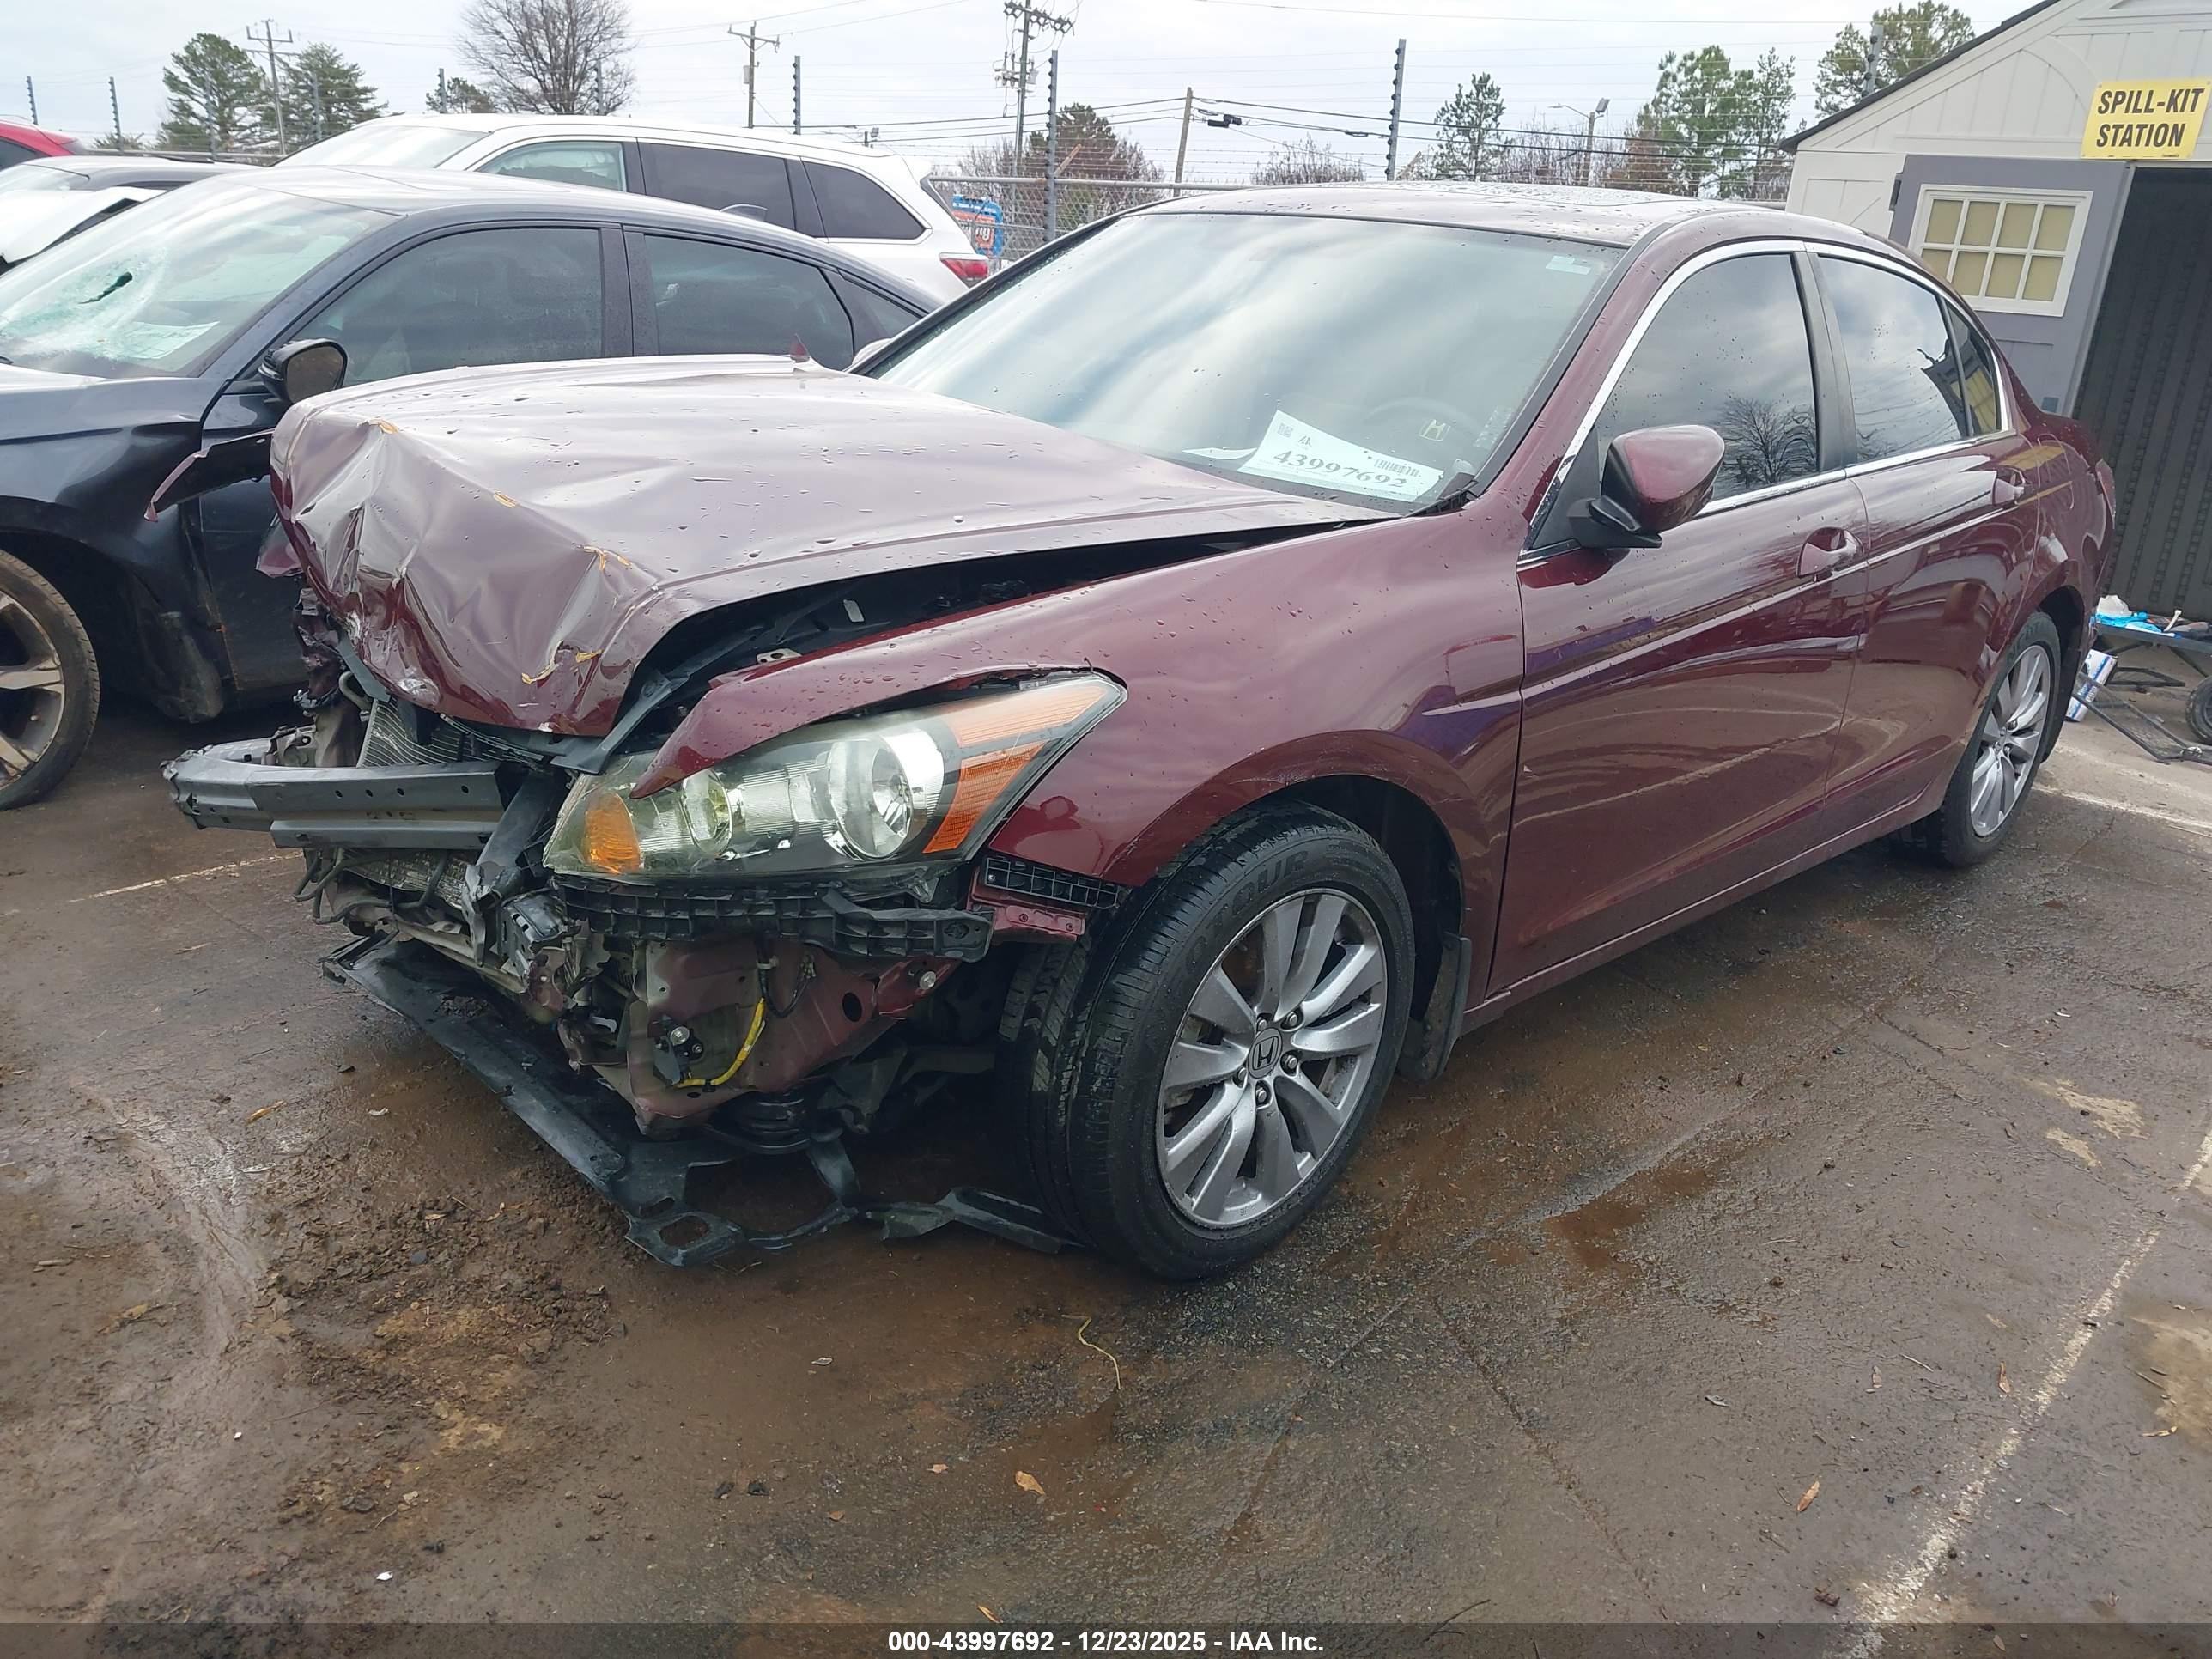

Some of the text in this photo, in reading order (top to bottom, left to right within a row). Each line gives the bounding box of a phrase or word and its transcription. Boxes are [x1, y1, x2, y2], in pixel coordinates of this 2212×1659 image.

[2097, 88, 2205, 114] SPILL-KIT
[2096, 123, 2186, 148] STATION
[1273, 450, 1408, 488] 43997692
